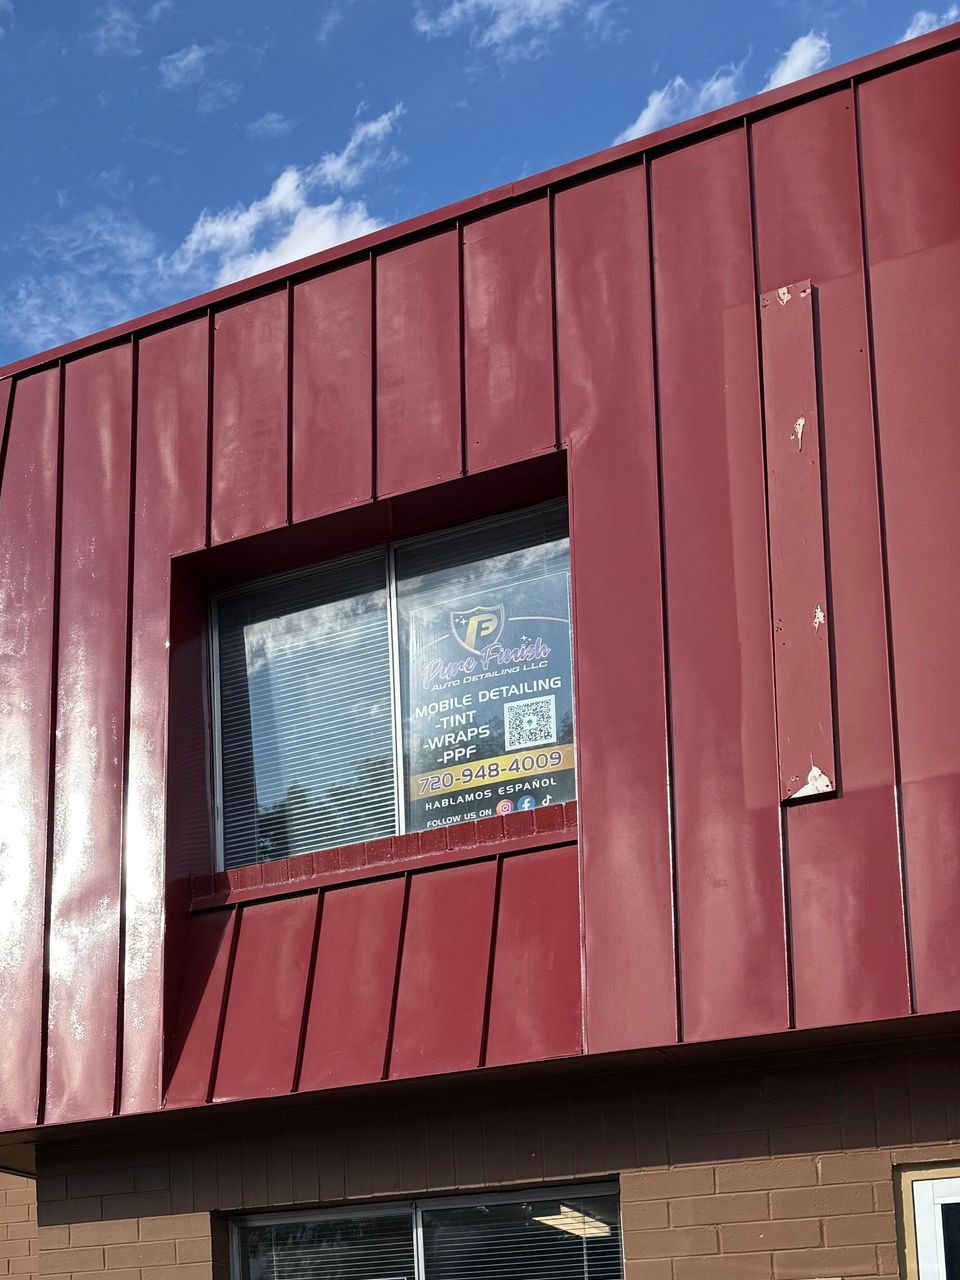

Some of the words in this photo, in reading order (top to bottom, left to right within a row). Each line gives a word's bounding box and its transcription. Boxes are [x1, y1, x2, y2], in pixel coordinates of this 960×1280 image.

[422, 655, 478, 690] Pure
[478, 637, 552, 671] Finish
[431, 679, 460, 692] AUTO
[463, 666, 520, 683] DETAILING
[523, 660, 549, 671] LLC
[415, 693, 473, 719] MOBILE
[478, 676, 562, 703] DETAILING
[435, 710, 477, 730] -TINT
[423, 724, 490, 750] -WRAPS
[437, 745, 477, 764] -PPF
[419, 751, 563, 795] 720-948-4009
[425, 789, 493, 811] HABLAMOS
[497, 776, 558, 796] ESPAÑOL
[426, 815, 462, 828] FOLLOW
[464, 810, 477, 821] US
[479, 808, 492, 818] ON
